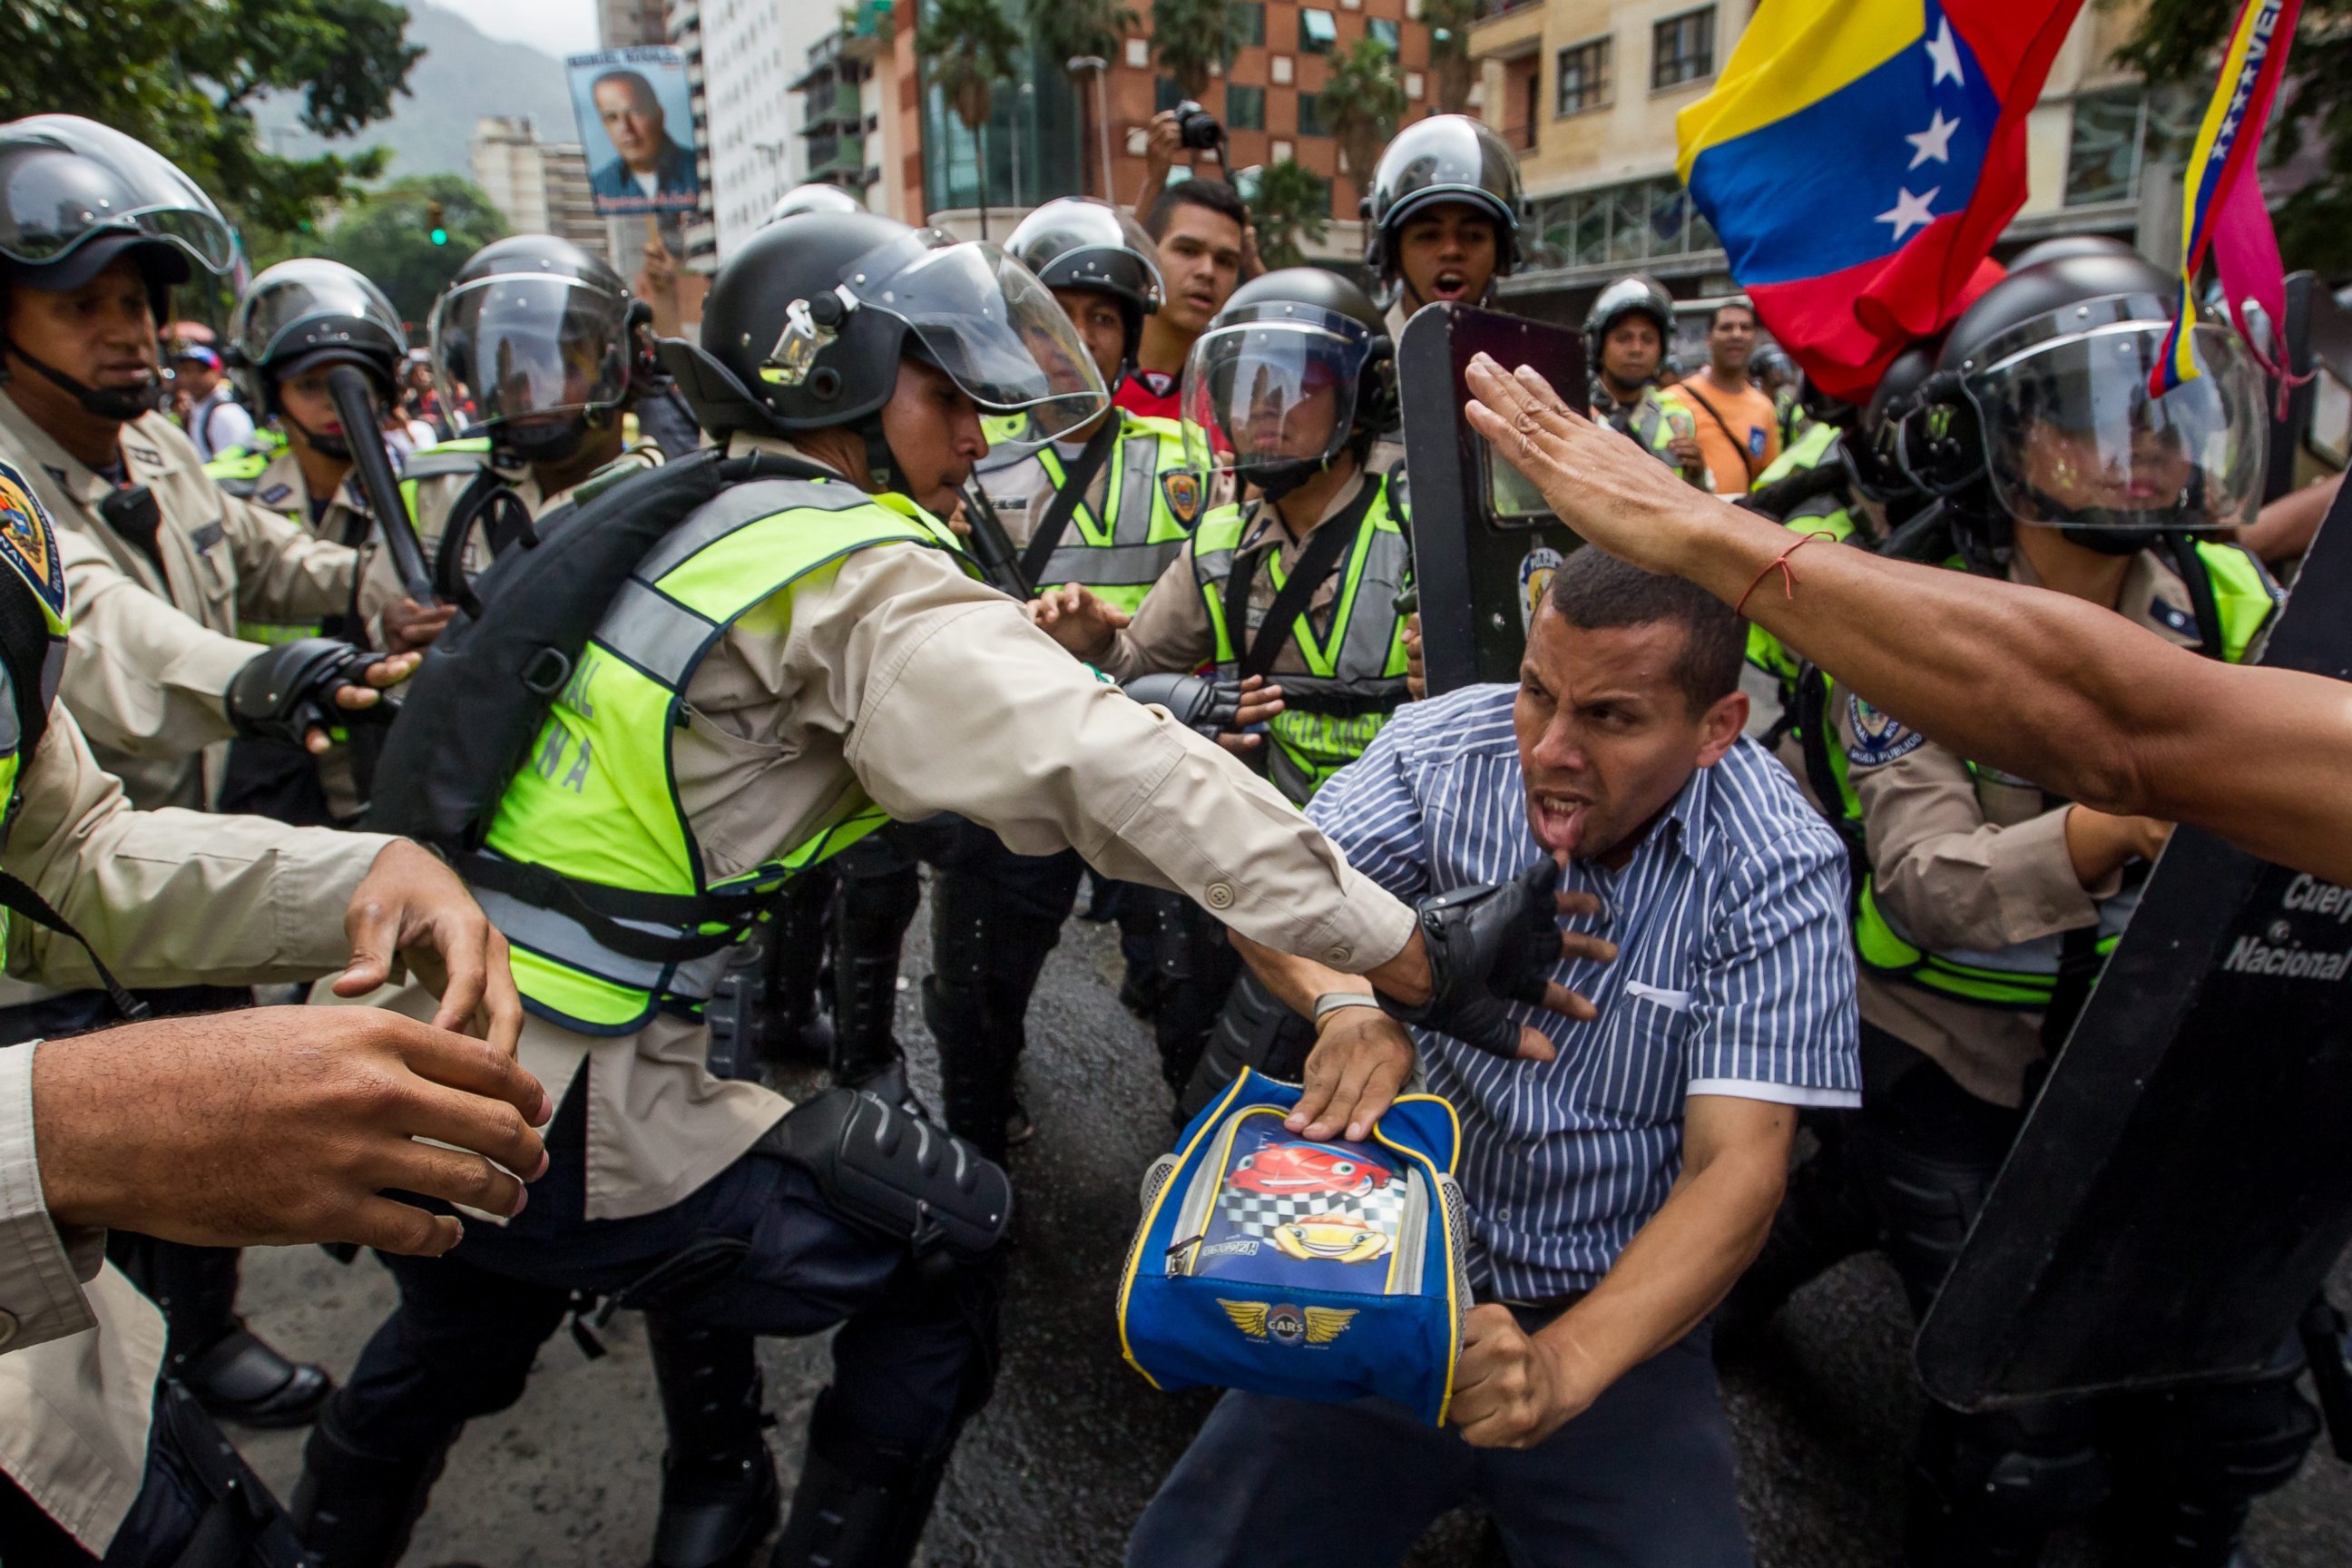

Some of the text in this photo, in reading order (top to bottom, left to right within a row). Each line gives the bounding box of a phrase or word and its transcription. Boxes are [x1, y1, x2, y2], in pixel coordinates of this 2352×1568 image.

[2241, 0, 2283, 61] VE
[2223, 935, 2352, 981] Nacional
[1268, 1320, 1304, 1333] CARS
